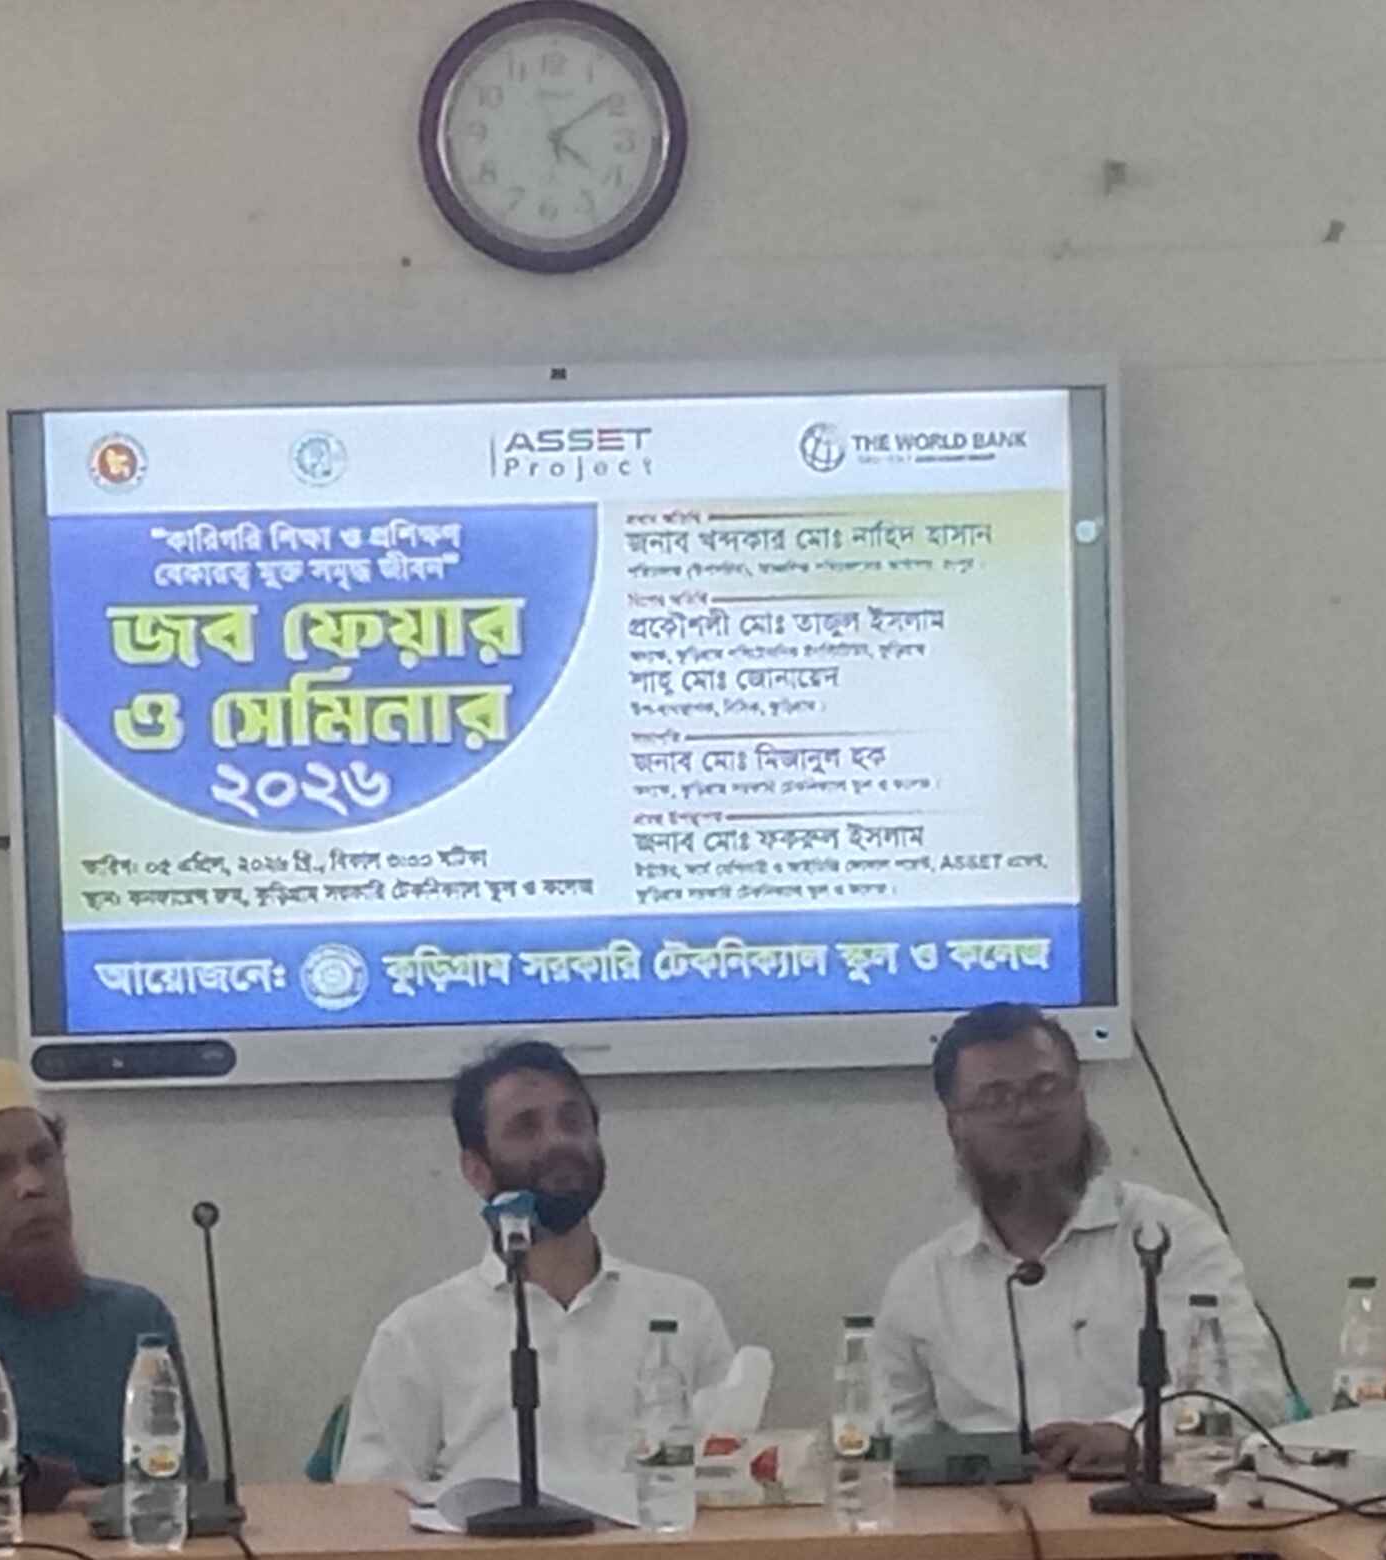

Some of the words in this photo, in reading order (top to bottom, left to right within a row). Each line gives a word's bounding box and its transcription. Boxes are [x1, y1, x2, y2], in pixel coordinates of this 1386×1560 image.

[504, 426, 653, 455] ASSET
[852, 433, 891, 452] THE
[895, 431, 968, 451] WORLD
[971, 430, 1028, 449] BANK
[504, 456, 653, 478] Project
[340, 526, 363, 550] ও
[625, 530, 689, 556] জনাব
[105, 604, 260, 668] জব
[282, 596, 528, 669] ফেয়ার
[112, 692, 186, 752] ও
[210, 666, 513, 752] সেমিনার
[630, 750, 694, 776] জনাব
[210, 759, 392, 818] ২০২৬
[632, 831, 695, 856] জনাব
[846, 822, 925, 852] ইসলাম
[382, 944, 514, 998] কুড়িগ্রাম
[519, 940, 644, 987] সরকারি
[653, 933, 830, 982] টেকনিক্যাল
[835, 941, 901, 984] স্কুল
[909, 942, 941, 972] ও
[946, 936, 1053, 973] কলেজ
